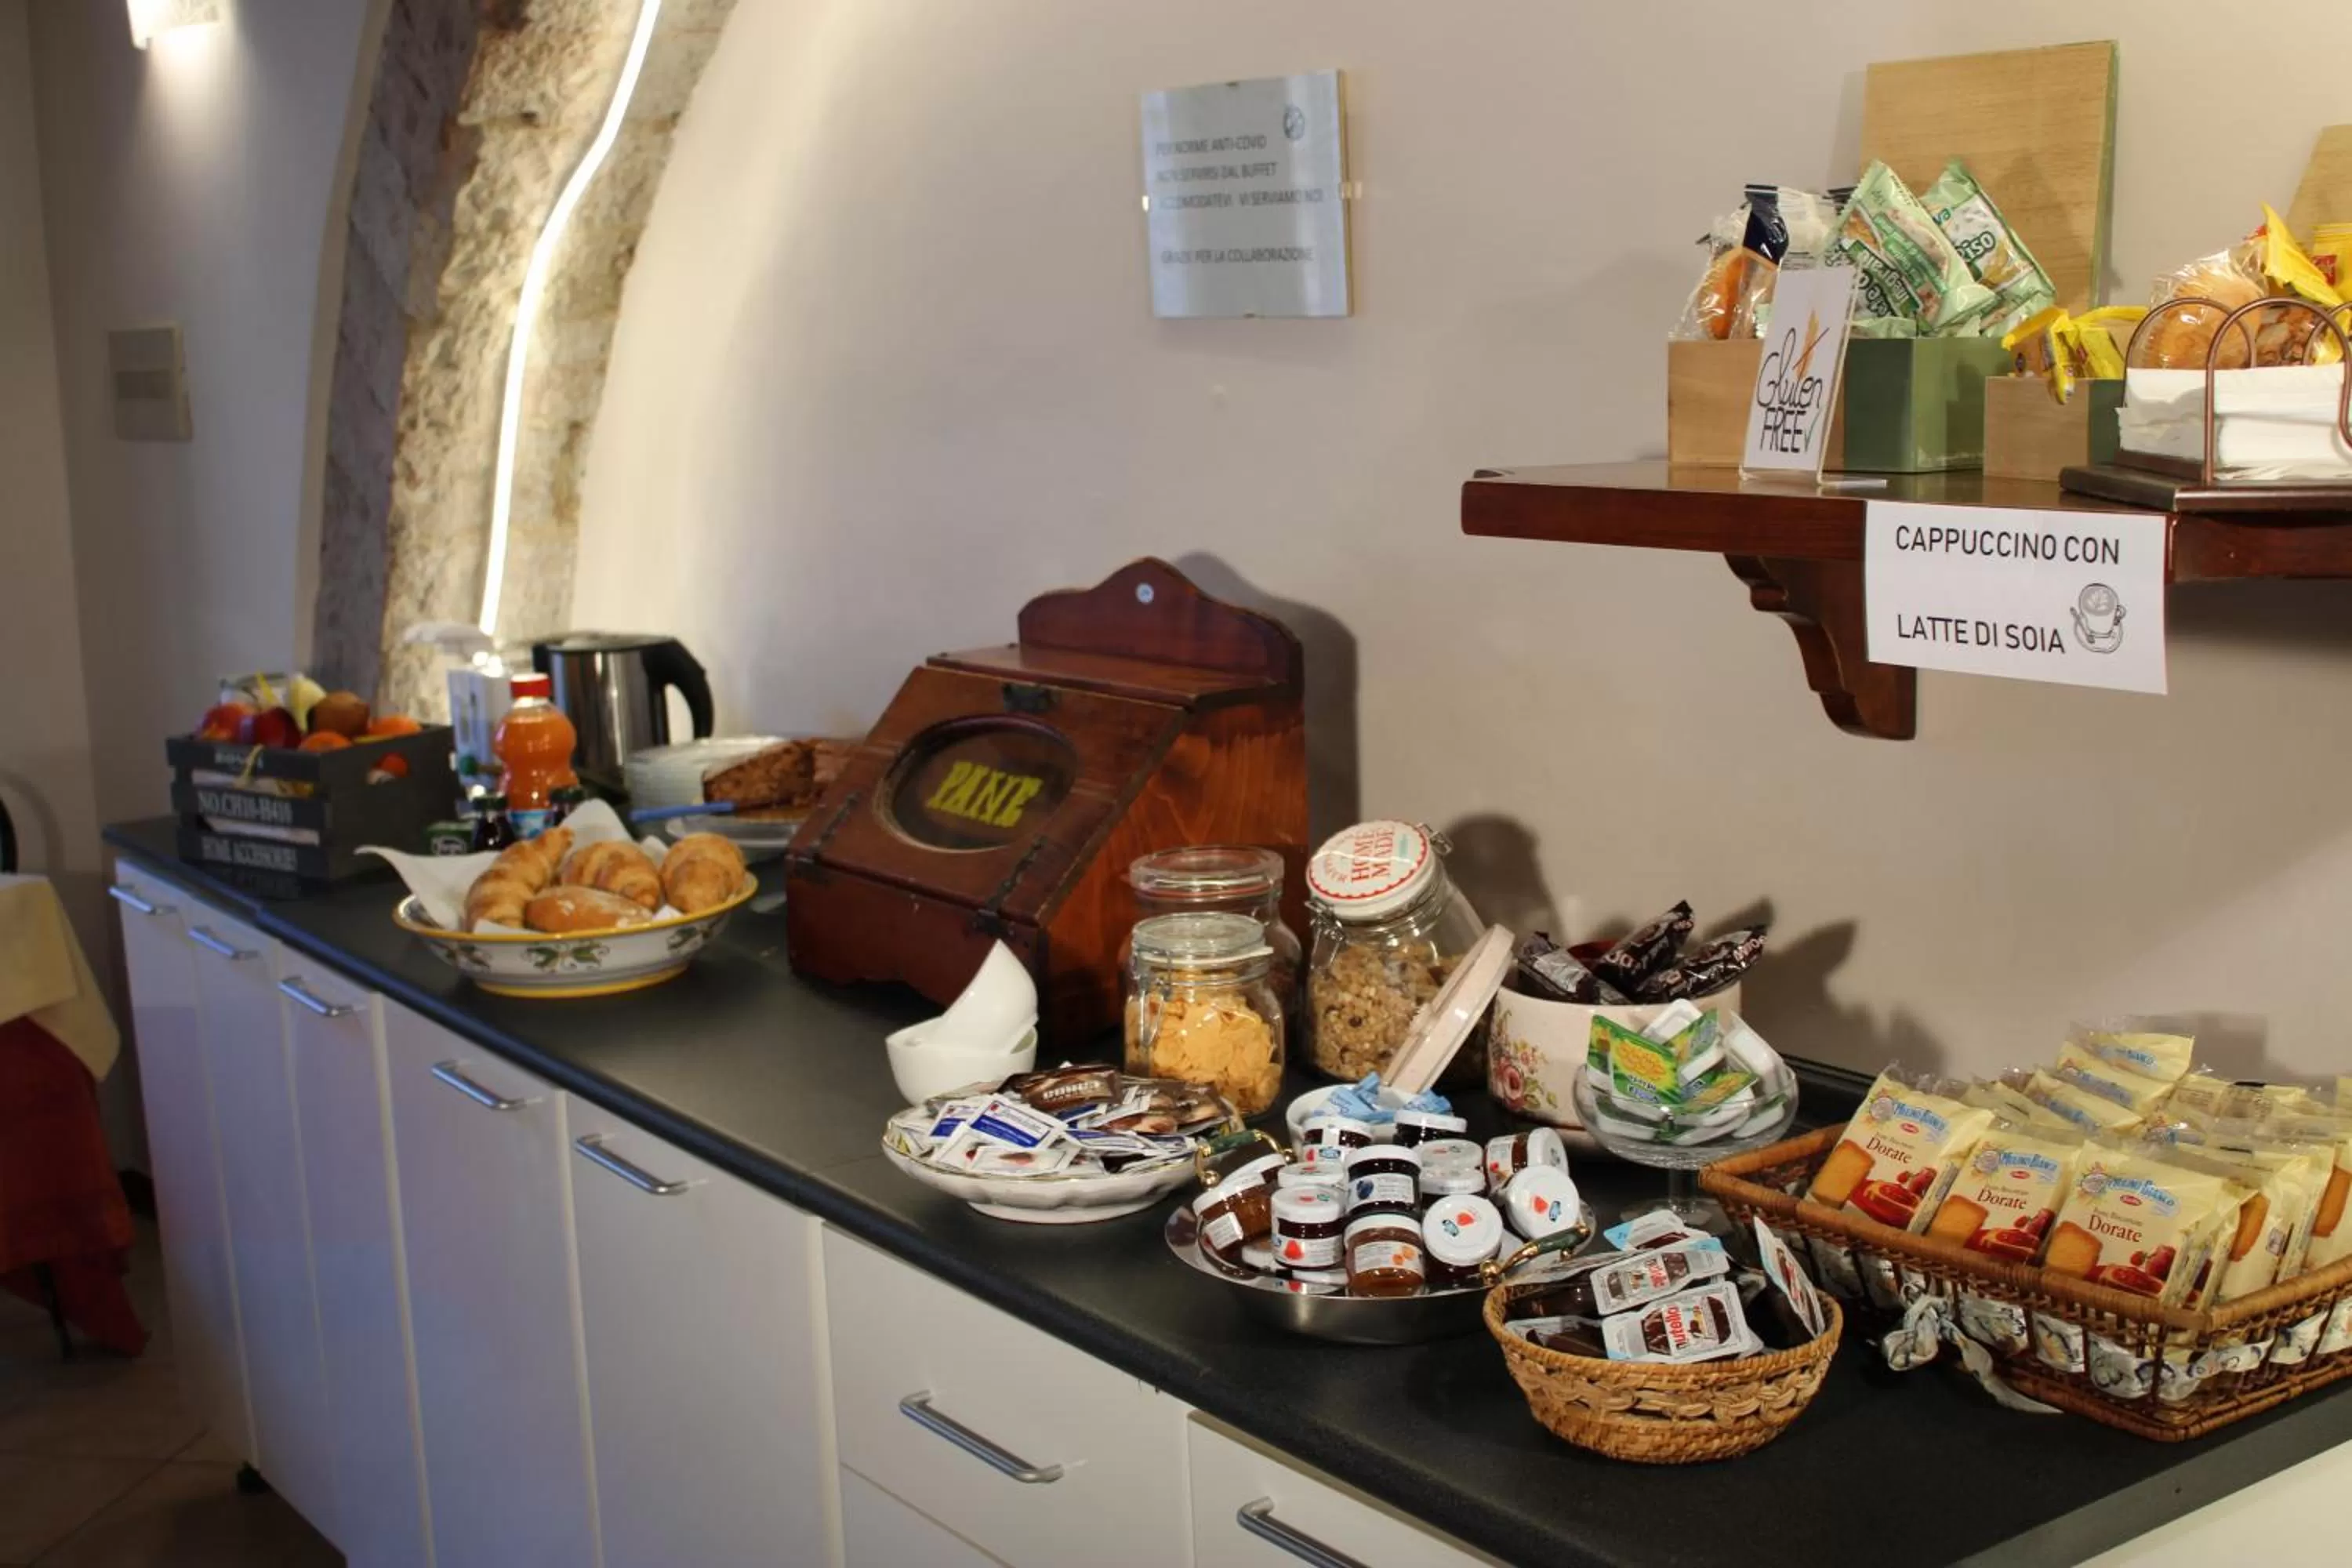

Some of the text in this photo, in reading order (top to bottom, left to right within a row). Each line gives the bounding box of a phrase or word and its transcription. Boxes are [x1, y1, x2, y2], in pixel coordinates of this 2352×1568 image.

[1211, 136, 1267, 151] ANTI-COVID
[1242, 162, 1279, 177] BUFFET
[1759, 408, 1806, 453] FREE
[1896, 524, 2120, 565] CAPPUCCINO CON
[1896, 614, 2067, 655] LATTE DI SOIA
[924, 760, 1044, 829] PANE
[1865, 1137, 1913, 1164] Dorate
[1976, 1189, 2027, 1210] Dorate
[2088, 1214, 2143, 1243] Dorate
[1664, 1305, 1688, 1349] nutella
